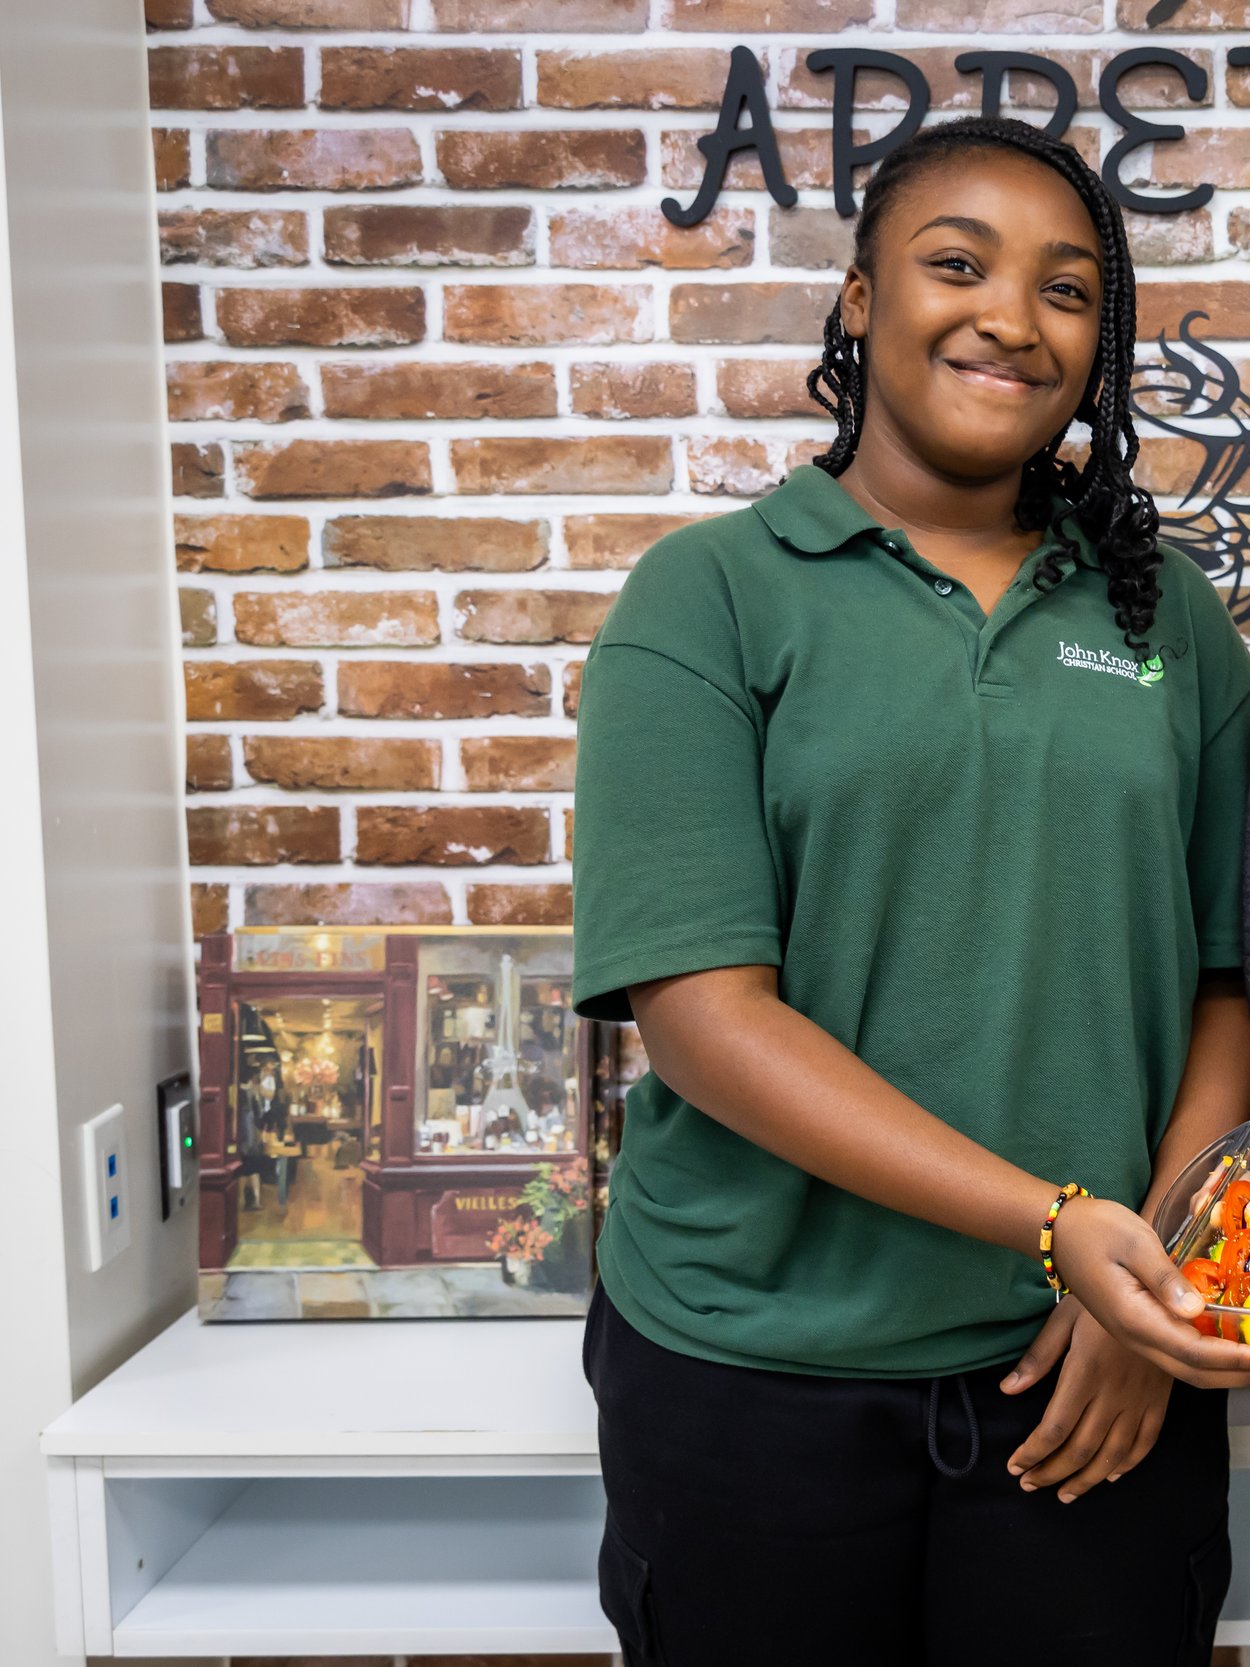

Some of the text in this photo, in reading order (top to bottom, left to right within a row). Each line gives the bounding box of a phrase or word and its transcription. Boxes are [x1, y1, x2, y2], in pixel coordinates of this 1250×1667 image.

[1056, 641, 1140, 673] John Knox
[1063, 657, 1138, 681] CHRISTIAN SCHOOL
